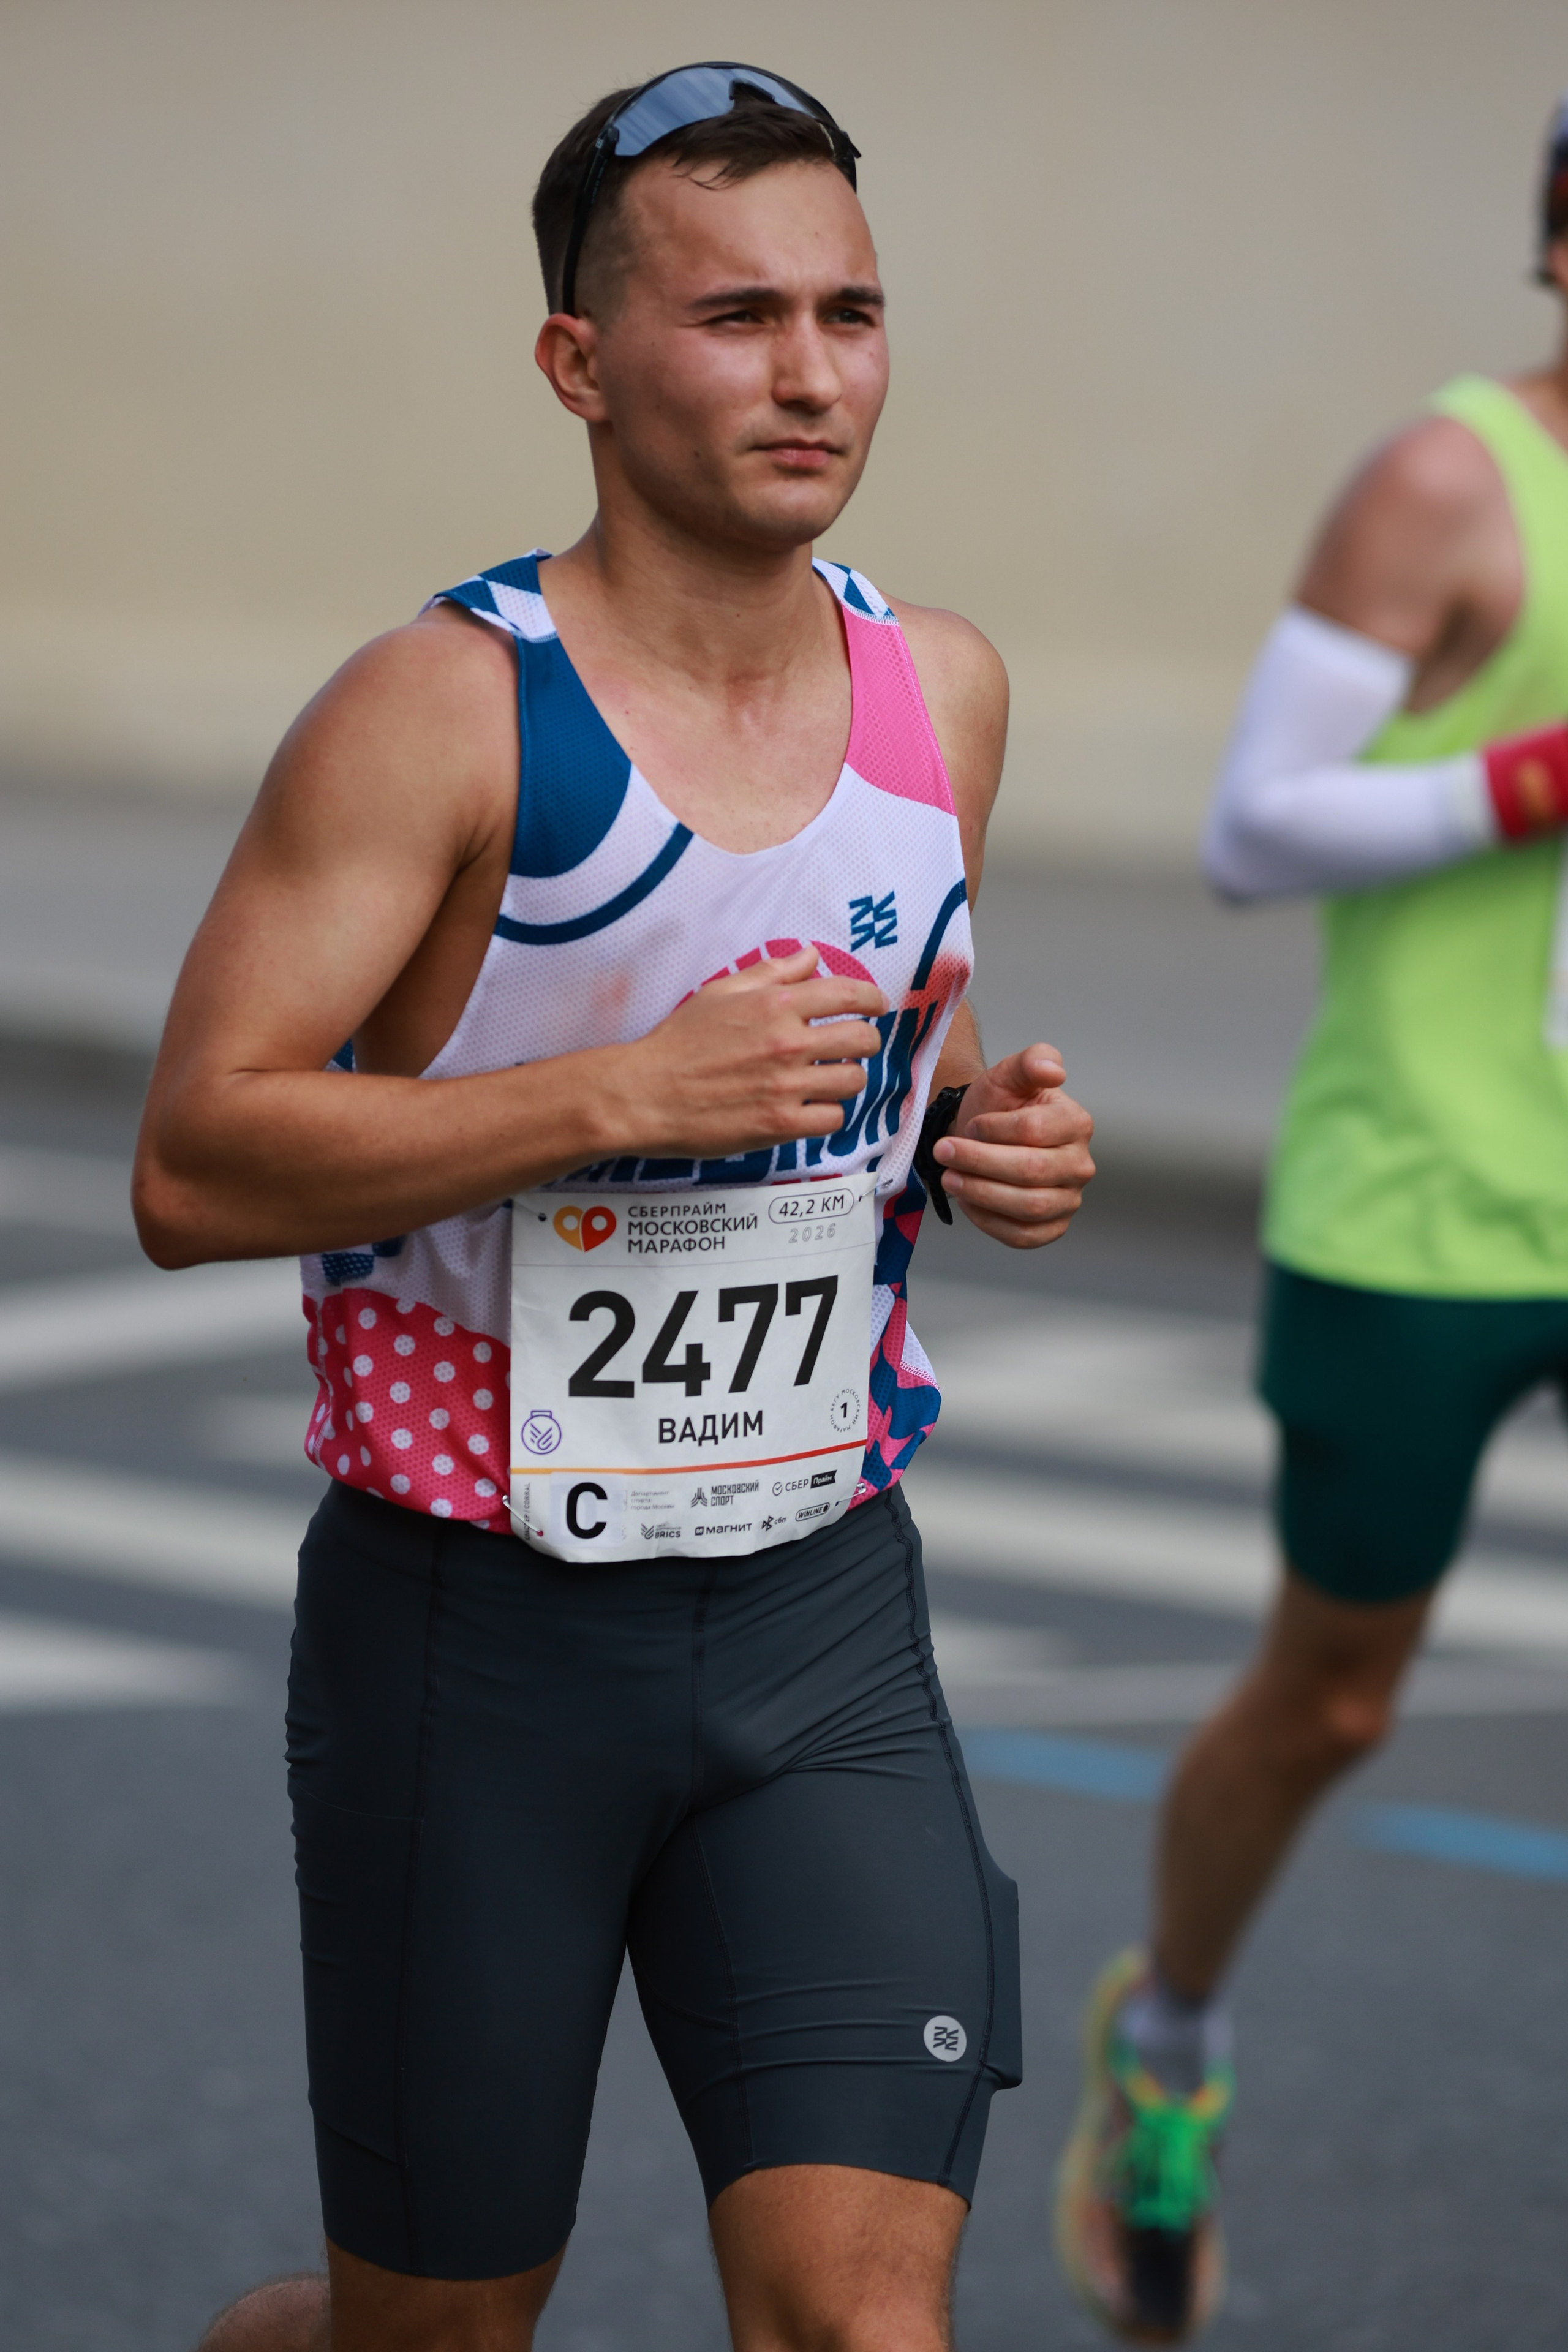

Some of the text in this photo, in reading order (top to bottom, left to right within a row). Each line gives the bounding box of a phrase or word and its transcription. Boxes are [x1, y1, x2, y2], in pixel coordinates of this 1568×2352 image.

[628, 1202, 726, 1218] СБЕРПРАЙМ
[778, 1199, 815, 1218] 42,2
[628, 1213, 758, 1235] МОСКОВСКИЙ
[788, 1223, 836, 1243] 2026
[628, 1237, 725, 1253] МАРАФОН
[568, 1275, 839, 1398] 2477
[840, 1401, 848, 1418] 1
[658, 1410, 763, 1447] ВАДИМ
[711, 1480, 760, 1496] МОСКОВСКИЙ
[785, 1475, 832, 1491] СБЕР Прайм
[711, 1495, 734, 1507] СПОРТ
[798, 1506, 823, 1519] WINLINE
